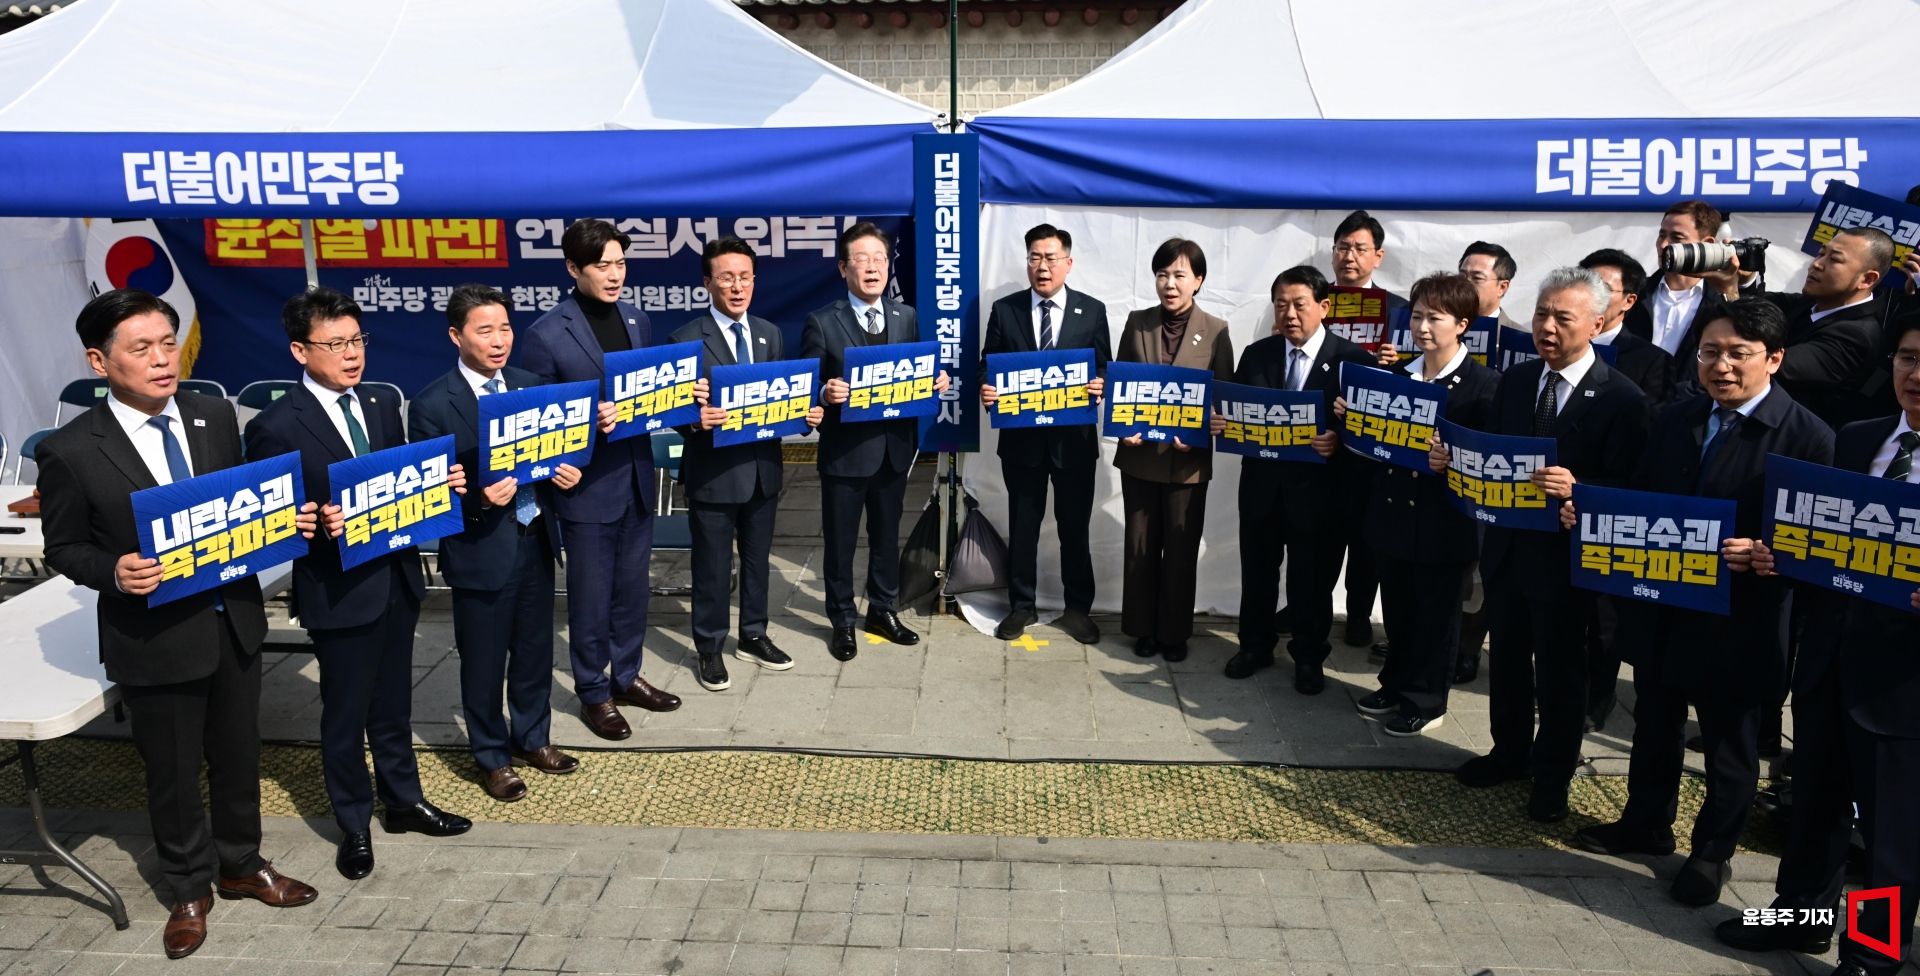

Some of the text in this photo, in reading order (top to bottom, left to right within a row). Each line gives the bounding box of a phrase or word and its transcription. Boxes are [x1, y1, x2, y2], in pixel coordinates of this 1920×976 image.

[122, 150, 405, 206] 더불어민주당
[1536, 138, 1867, 195] 더불어민주당
[381, 218, 497, 259] 파면!
[934, 152, 962, 311] 더불어민주당
[353, 286, 428, 312] 민주당
[511, 286, 561, 311] 현장
[363, 273, 391, 288] 더불어
[936, 317, 962, 369] 천막
[614, 356, 697, 400] 내란수괴
[851, 354, 935, 389] 내란수괴
[996, 362, 1088, 394] 내란수괴
[615, 381, 694, 421] 즉각파면
[721, 373, 812, 409] 내란수괴
[851, 378, 933, 407] 즉각파면
[997, 386, 1089, 414] 즉각파면
[1113, 381, 1205, 405] 내란수괴
[1347, 386, 1438, 425] 내란수괴
[489, 397, 591, 447] 내란수괴
[722, 398, 810, 428] 즉각파면
[1113, 404, 1203, 428] 즉각파면
[1221, 400, 1316, 425] 내란수괴
[491, 426, 588, 469] 즉각파면
[1224, 422, 1316, 445] 즉각파면
[1346, 412, 1434, 451] 즉각파면
[341, 453, 448, 518] 내란수괴
[1448, 471, 1546, 507] 즉각파면
[151, 473, 295, 553] 내란수괴
[346, 485, 449, 544] 즉각파면
[161, 507, 296, 580] 즉각파면
[389, 535, 410, 548] 민주당
[1581, 513, 1720, 551] 내란수괴
[219, 562, 247, 580] 민주당
[1582, 545, 1718, 585] 즉각파면
[1833, 575, 1863, 592] 민주당
[1633, 586, 1659, 598] 민주당
